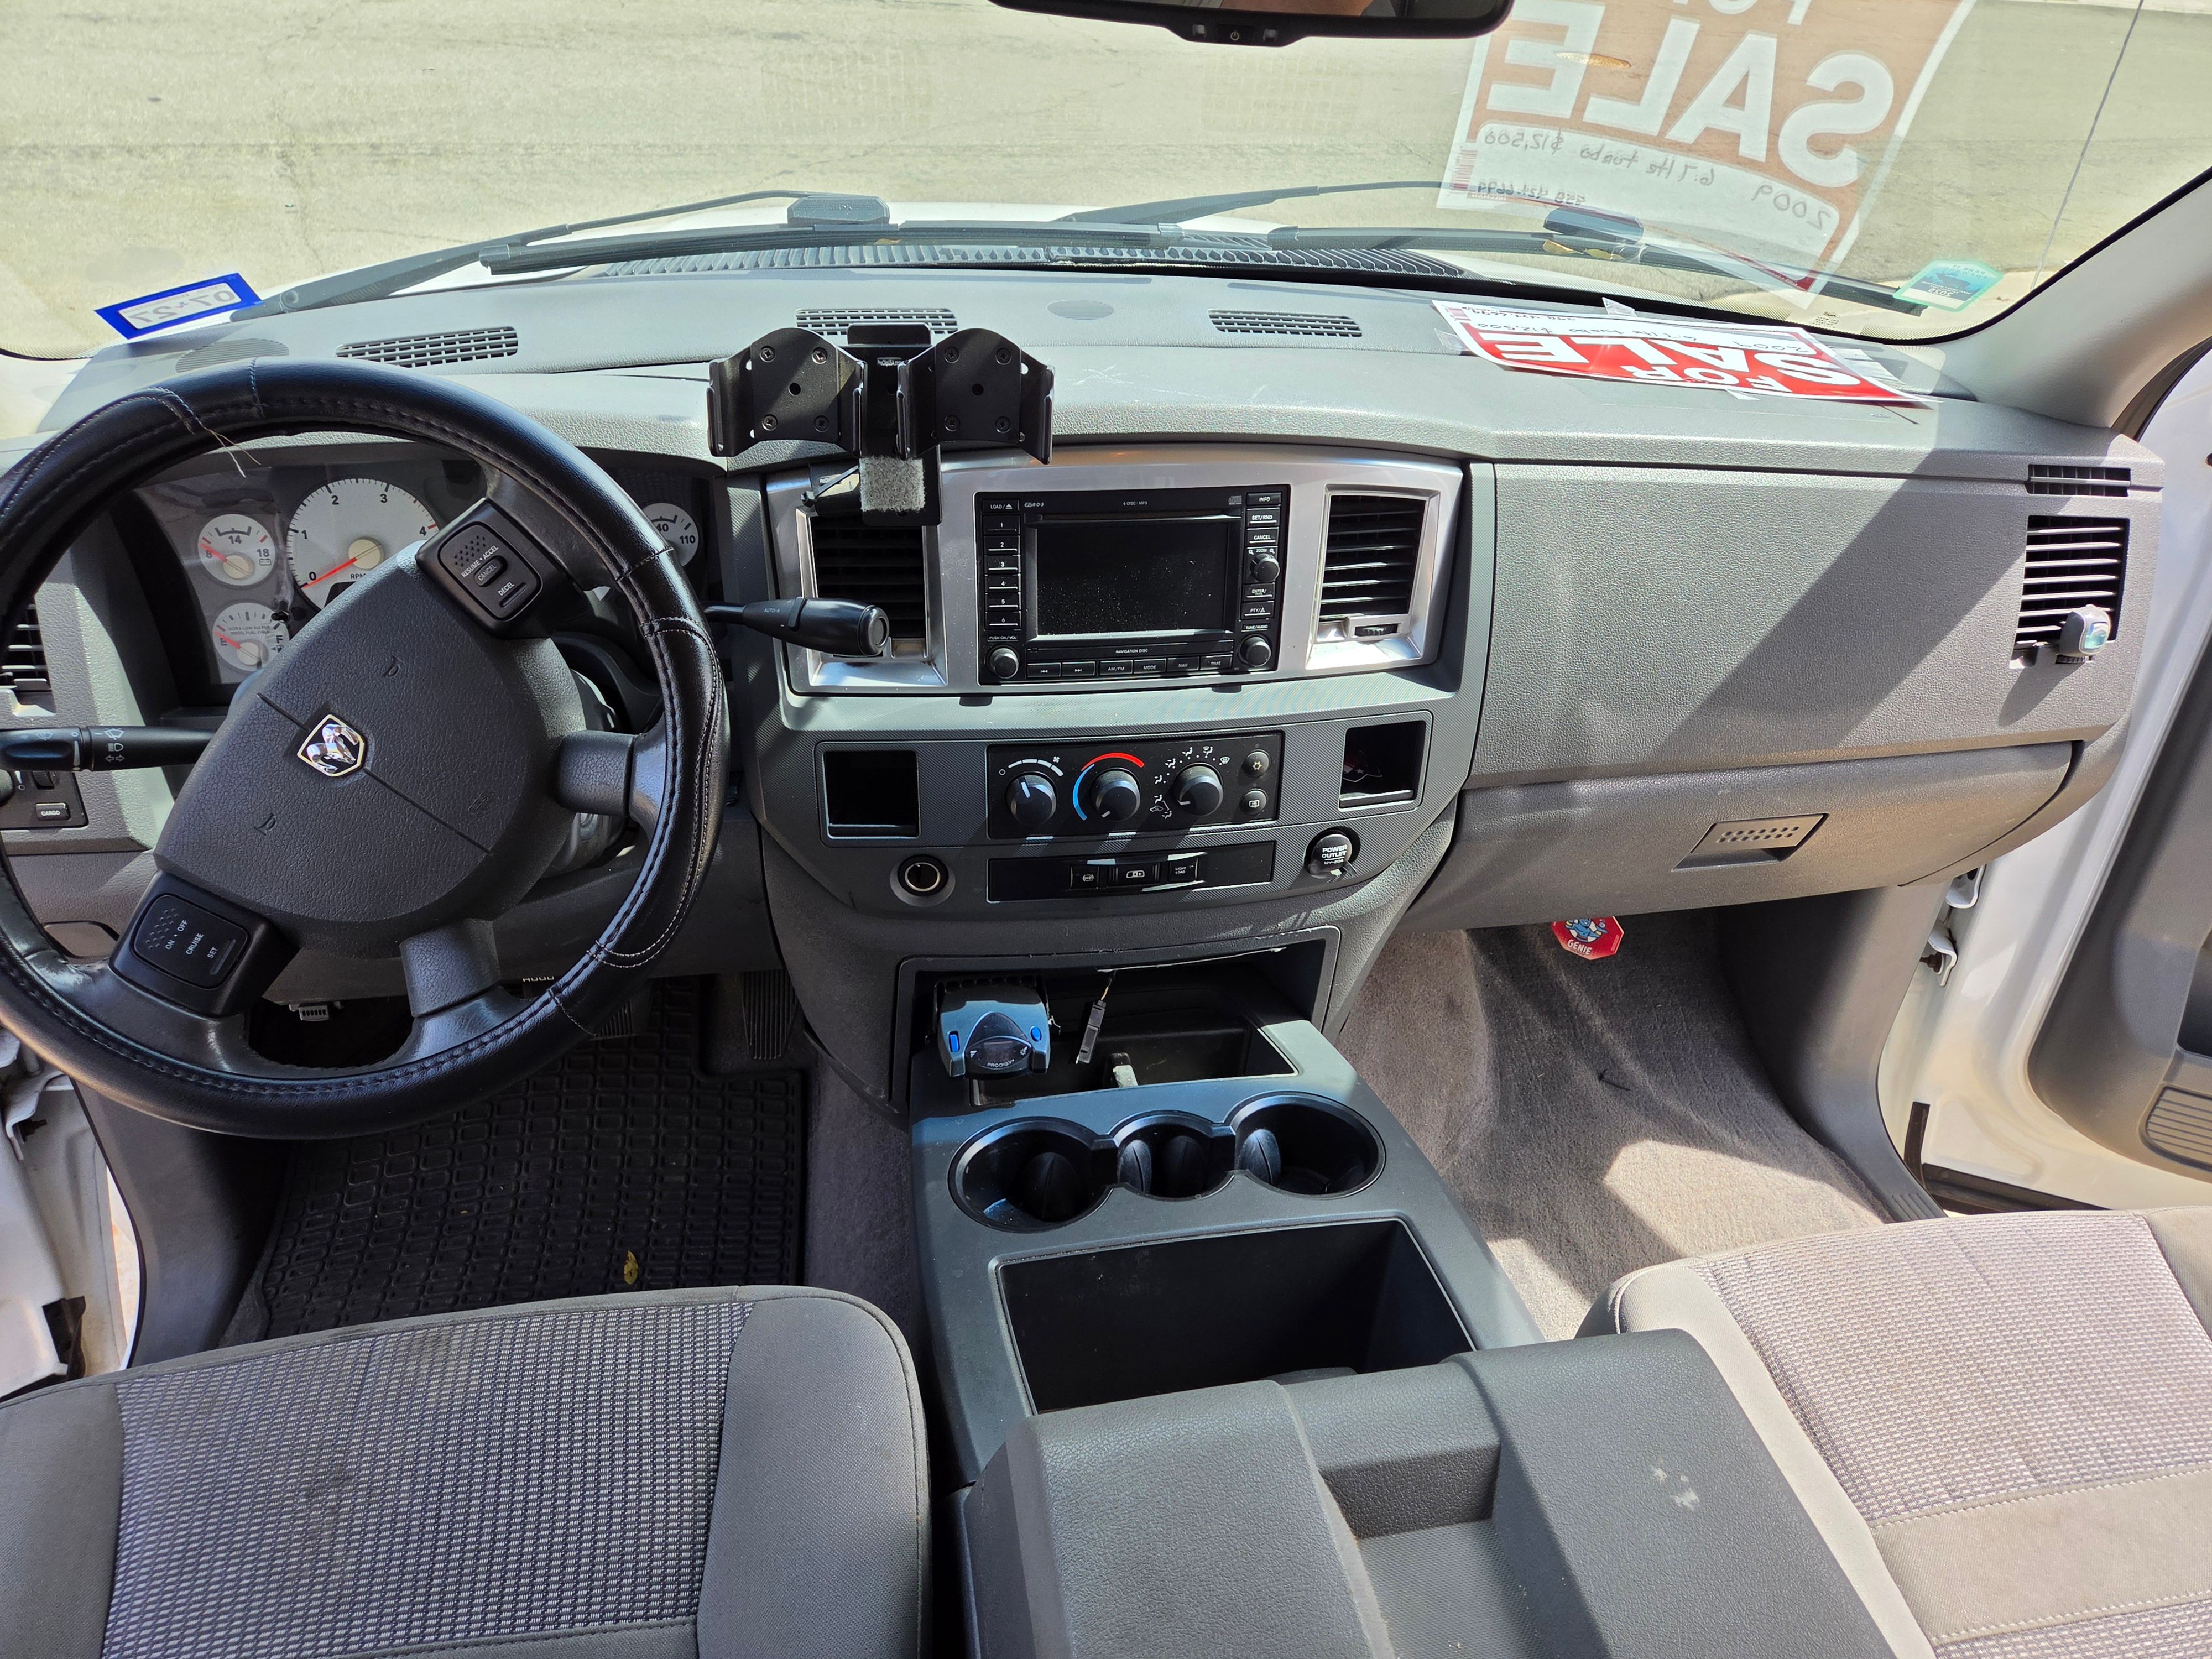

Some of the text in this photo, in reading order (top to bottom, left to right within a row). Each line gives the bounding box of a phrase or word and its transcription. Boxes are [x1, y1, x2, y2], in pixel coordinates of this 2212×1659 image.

[1733, 341, 1809, 353] 2009
[1478, 332, 1861, 385] SALE
[1620, 366, 1792, 392] FOR
[332, 495, 339, 505] 2
[380, 494, 388, 503] 3
[419, 526, 427, 536] 4
[656, 523, 669, 532] 40
[228, 535, 242, 544] 14
[301, 530, 307, 539] 1
[679, 535, 696, 544] 110
[257, 548, 270, 557] 18
[461, 545, 499, 578] RESUME ACCEL
[309, 572, 317, 581] 0
[477, 564, 497, 581] CANCEL
[498, 582, 515, 596] DECEL
[220, 638, 228, 646] E
[276, 635, 284, 644] F
[1322, 844, 1348, 853] POWER
[165, 919, 189, 951] ON OFF
[185, 932, 204, 956] CRUISE
[1567, 939, 1593, 955] GENIE
[207, 947, 218, 959] SET
[987, 1060, 1013, 1068] PRODIGY
